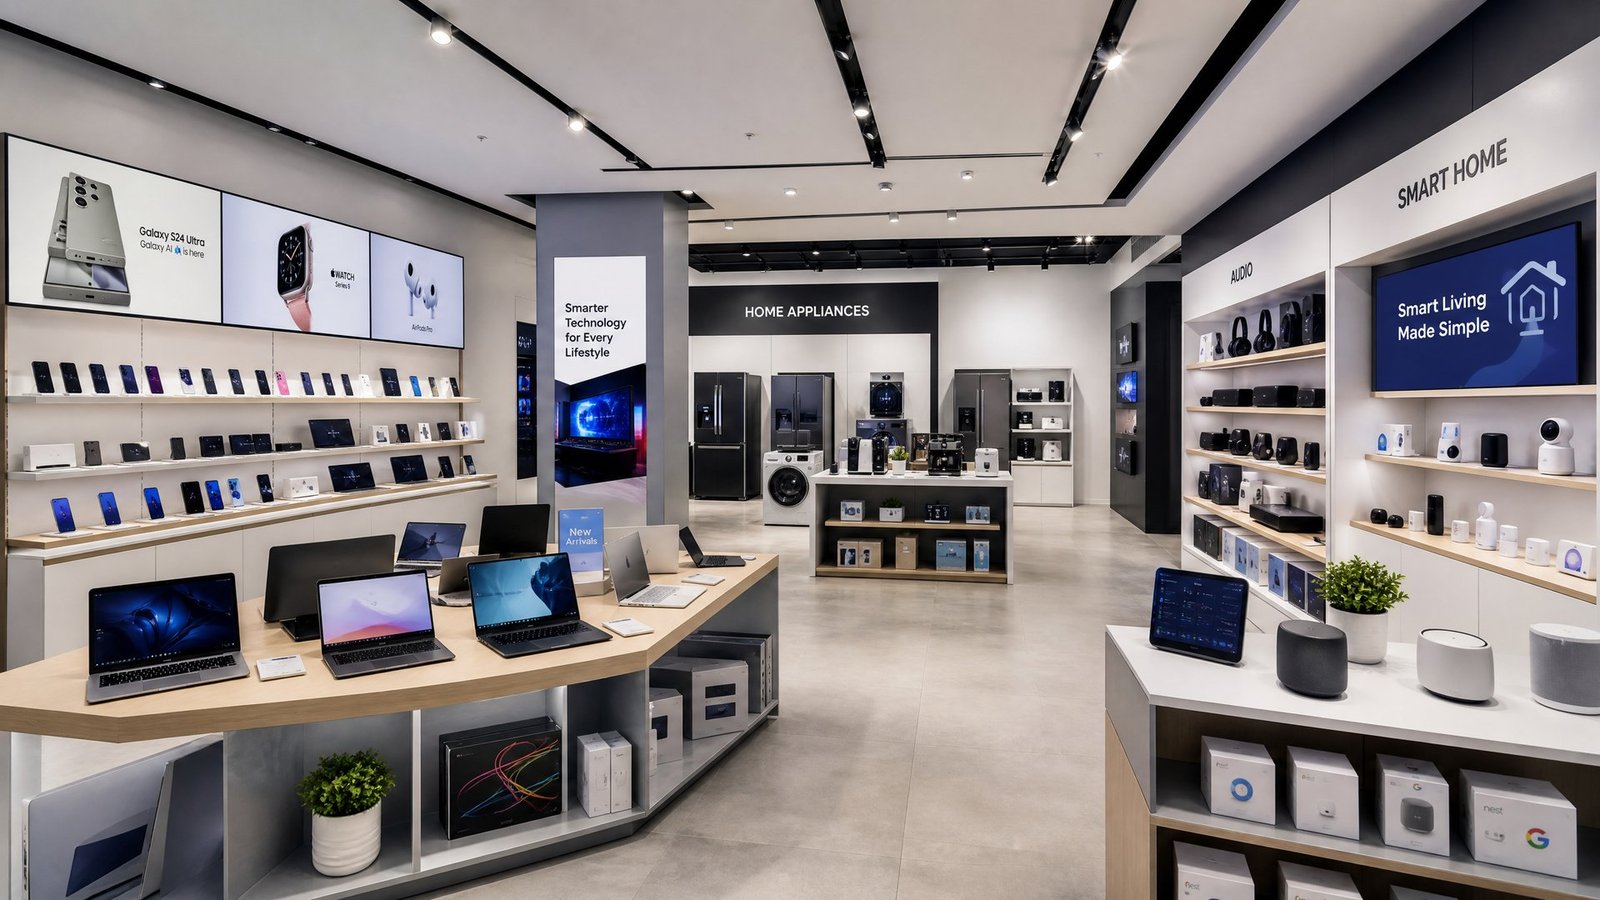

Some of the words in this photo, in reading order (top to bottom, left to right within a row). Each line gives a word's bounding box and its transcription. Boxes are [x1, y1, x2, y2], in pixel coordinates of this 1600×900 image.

[1398, 166, 1449, 209] SMART
[1453, 137, 1508, 185] HOME
[139, 226, 169, 243] Galaxy
[170, 232, 185, 243] S24
[186, 235, 205, 247] Ultra
[140, 240, 164, 253] Galaxy
[165, 244, 173, 253] AI
[182, 247, 188, 256] is
[189, 248, 205, 258] here
[335, 270, 355, 281] WATCH
[1231, 261, 1253, 285] AUDIO
[565, 302, 609, 313] Smarter
[745, 306, 784, 318] HOME
[787, 304, 870, 317] APPLIANCES
[1398, 299, 1439, 317] Smart
[1442, 292, 1487, 311] Living
[565, 317, 627, 330] Technology
[1398, 323, 1435, 341] Made
[1438, 316, 1490, 338] Simple
[565, 332, 580, 342] for
[583, 332, 614, 345] Every
[565, 347, 610, 360] Lifestyle
[569, 527, 592, 537] New
[565, 537, 598, 546] Arrivals
[1483, 805, 1504, 816] nest
